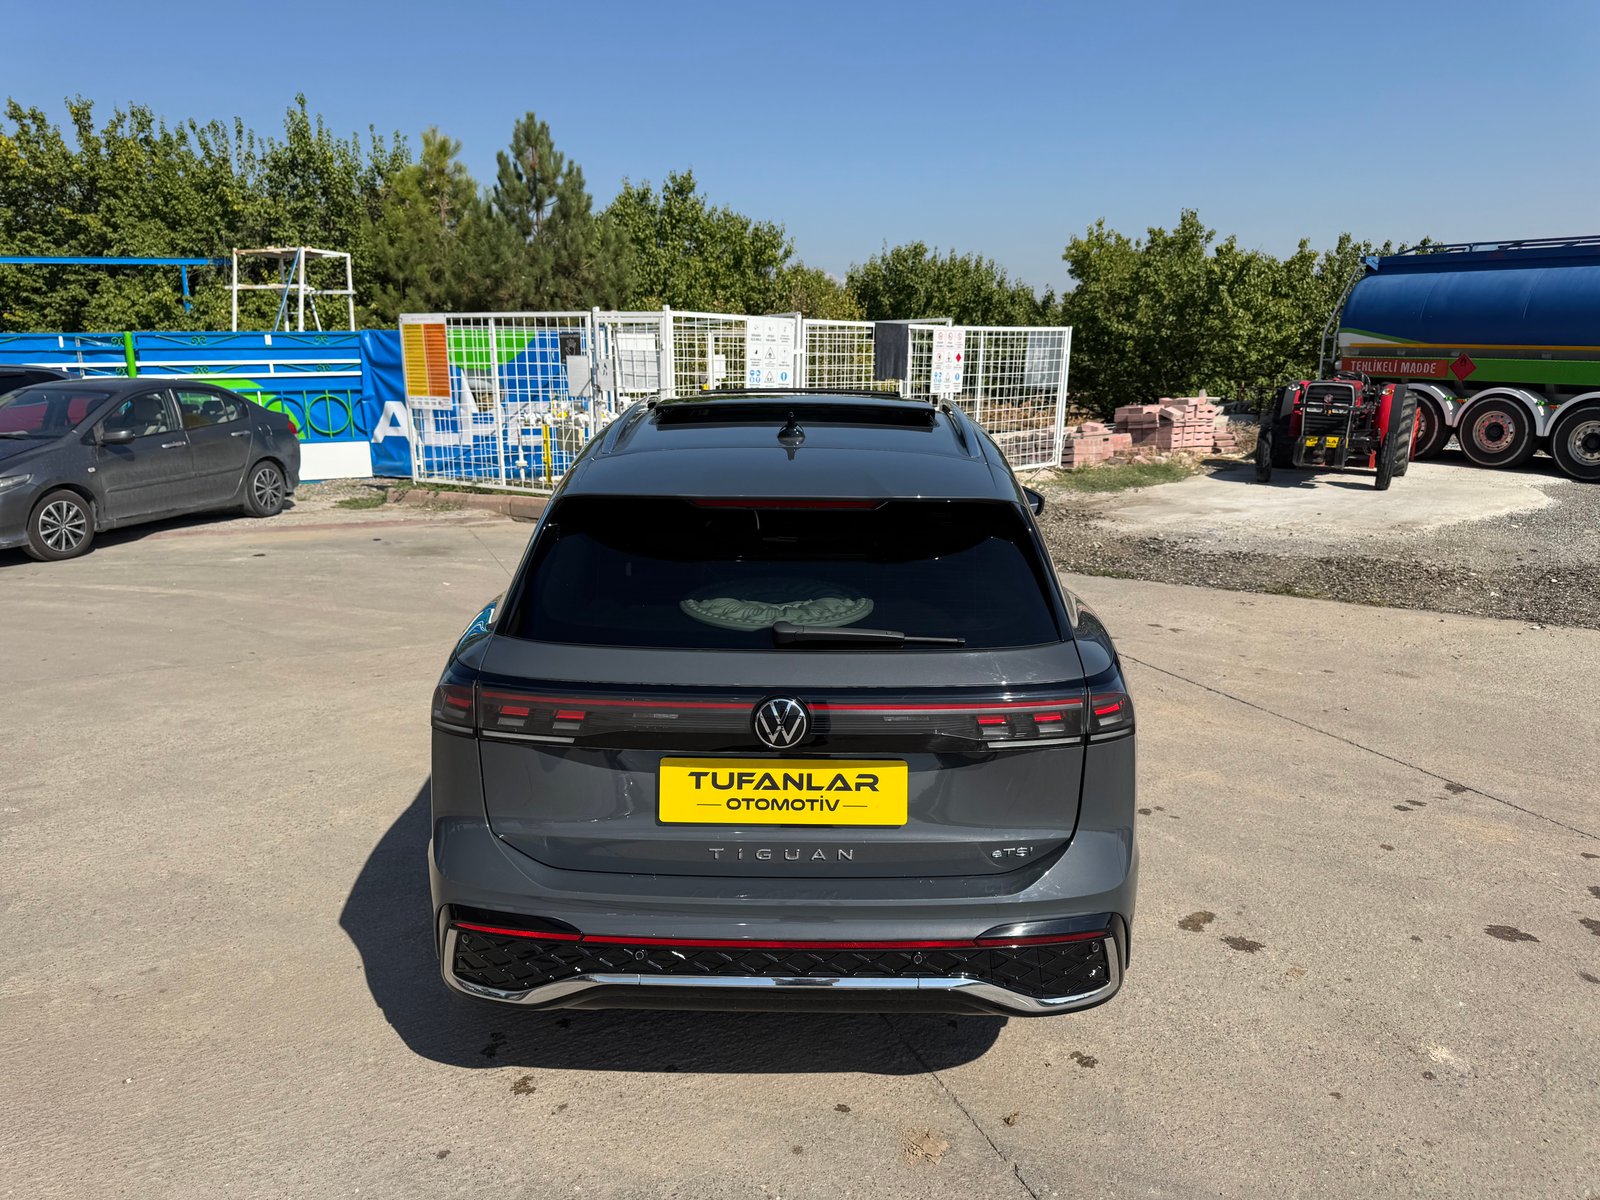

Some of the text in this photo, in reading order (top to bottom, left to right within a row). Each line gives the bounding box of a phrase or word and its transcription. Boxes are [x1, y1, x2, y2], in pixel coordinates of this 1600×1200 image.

[1351, 360, 1437, 374] TEHLİKELİ MADDE
[688, 771, 880, 792] TUFANLAR
[726, 795, 840, 812] OTOMOTİV
[708, 847, 854, 862] TIGUAN
